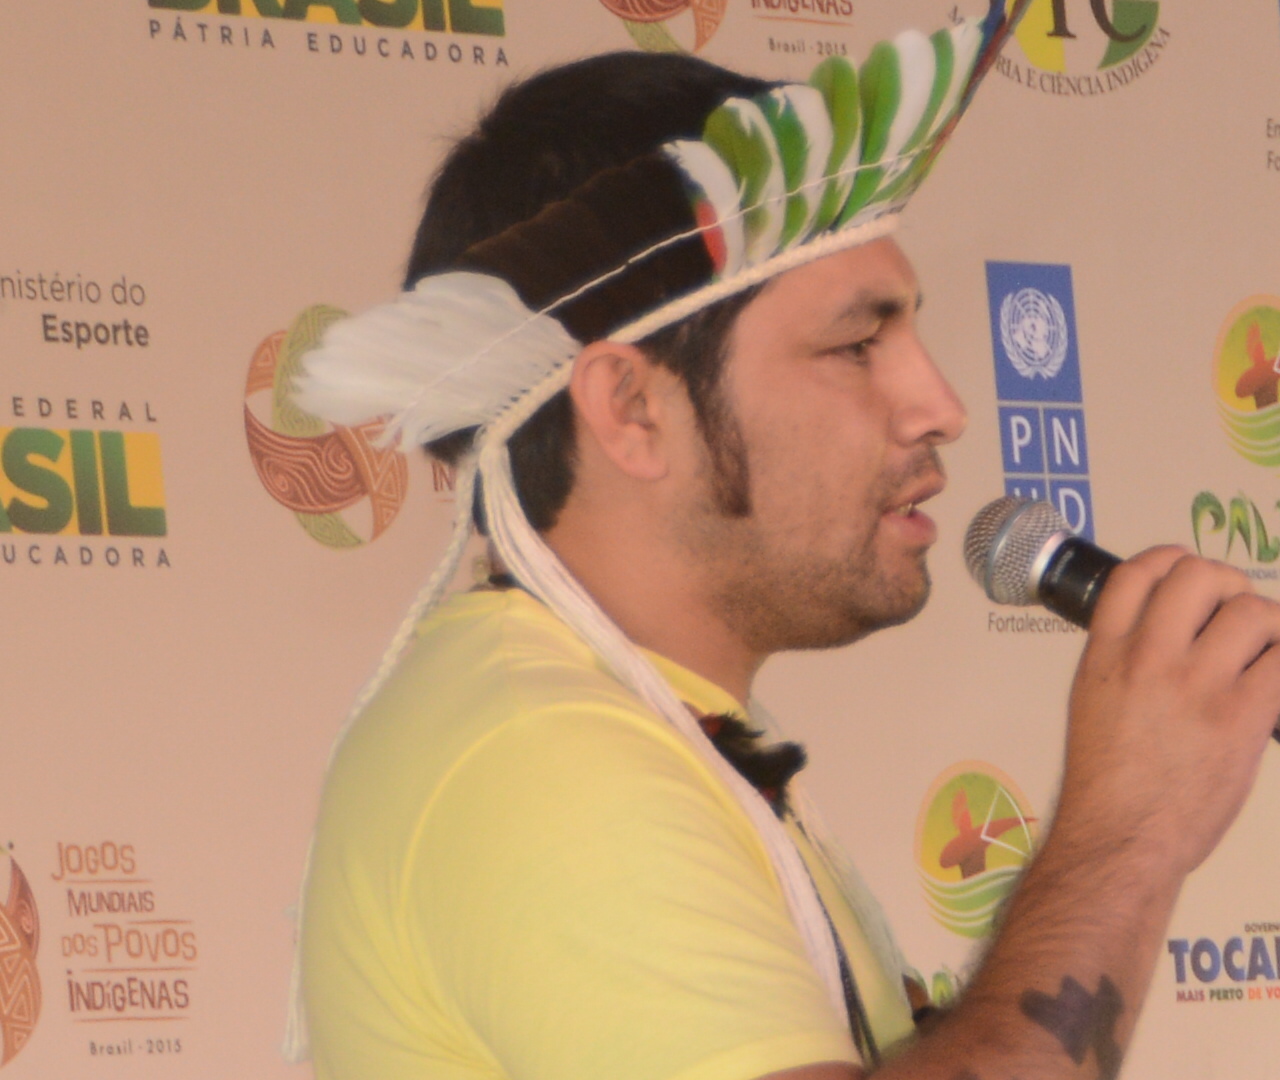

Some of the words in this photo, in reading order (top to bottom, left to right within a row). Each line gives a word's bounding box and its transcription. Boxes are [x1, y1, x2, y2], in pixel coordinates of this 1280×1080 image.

[149, 17, 276, 50] PÁTRIA
[306, 31, 510, 68] EDUCADORA
[0, 270, 102, 305] nistério
[111, 275, 147, 307] do
[41, 313, 151, 350] Esporte
[12, 396, 157, 423] EDERAL
[0, 427, 168, 538] SIL
[0, 543, 172, 569] UCADORA
[51, 841, 136, 881] JOGOS
[66, 888, 155, 917] MUNDIAIS
[61, 932, 99, 958] DOS
[94, 923, 198, 964] POVOS
[1176, 989, 1205, 1002] MAIS
[1208, 987, 1244, 1001] PERTO
[1247, 986, 1263, 1000] DE
[89, 1038, 133, 1056] Brasil
[147, 1038, 182, 1054] 2015
